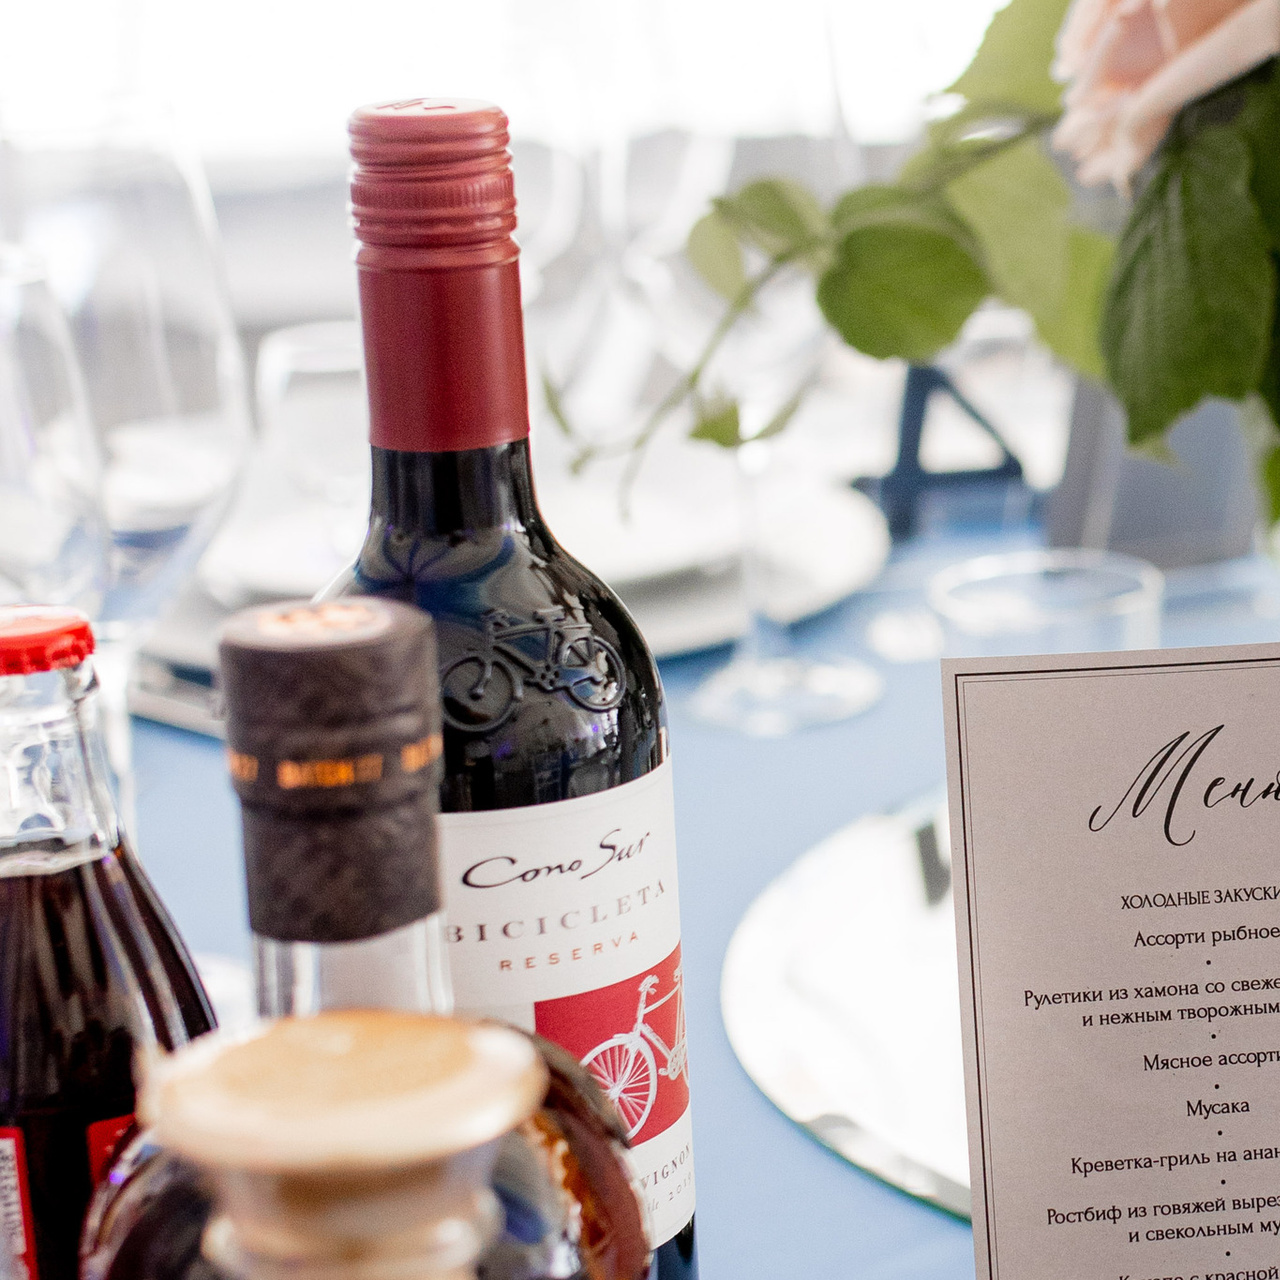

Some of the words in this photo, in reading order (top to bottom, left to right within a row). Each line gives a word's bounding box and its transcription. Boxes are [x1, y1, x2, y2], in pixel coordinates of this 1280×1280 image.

[461, 855, 582, 889] Cono
[580, 828, 651, 880] Sur
[446, 879, 666, 944] BICICLETA
[1120, 890, 1211, 910] ХОЛОДНЫЕ
[1133, 930, 1206, 950] Ассорти
[1211, 925, 1280, 948] рыбное
[500, 931, 639, 972] RESERVA
[1023, 989, 1104, 1011] Рулетики
[1108, 988, 1129, 1001] из
[1133, 983, 1200, 999] хамона
[1204, 981, 1226, 994] со
[1082, 1014, 1094, 1027] и
[1098, 1009, 1173, 1026] нежным
[1176, 1001, 1280, 1023] творожным
[1143, 1053, 1213, 1072] Мясное
[1186, 1099, 1251, 1121] Мусака
[1070, 1152, 1211, 1179] Креветка-гриль
[1216, 1150, 1238, 1163] на
[1046, 1204, 1123, 1226] Ростбиф
[1127, 1206, 1148, 1219] из
[1152, 1197, 1227, 1217] говяжей
[1128, 1230, 1140, 1243] и
[1145, 1221, 1254, 1242] свекольным
